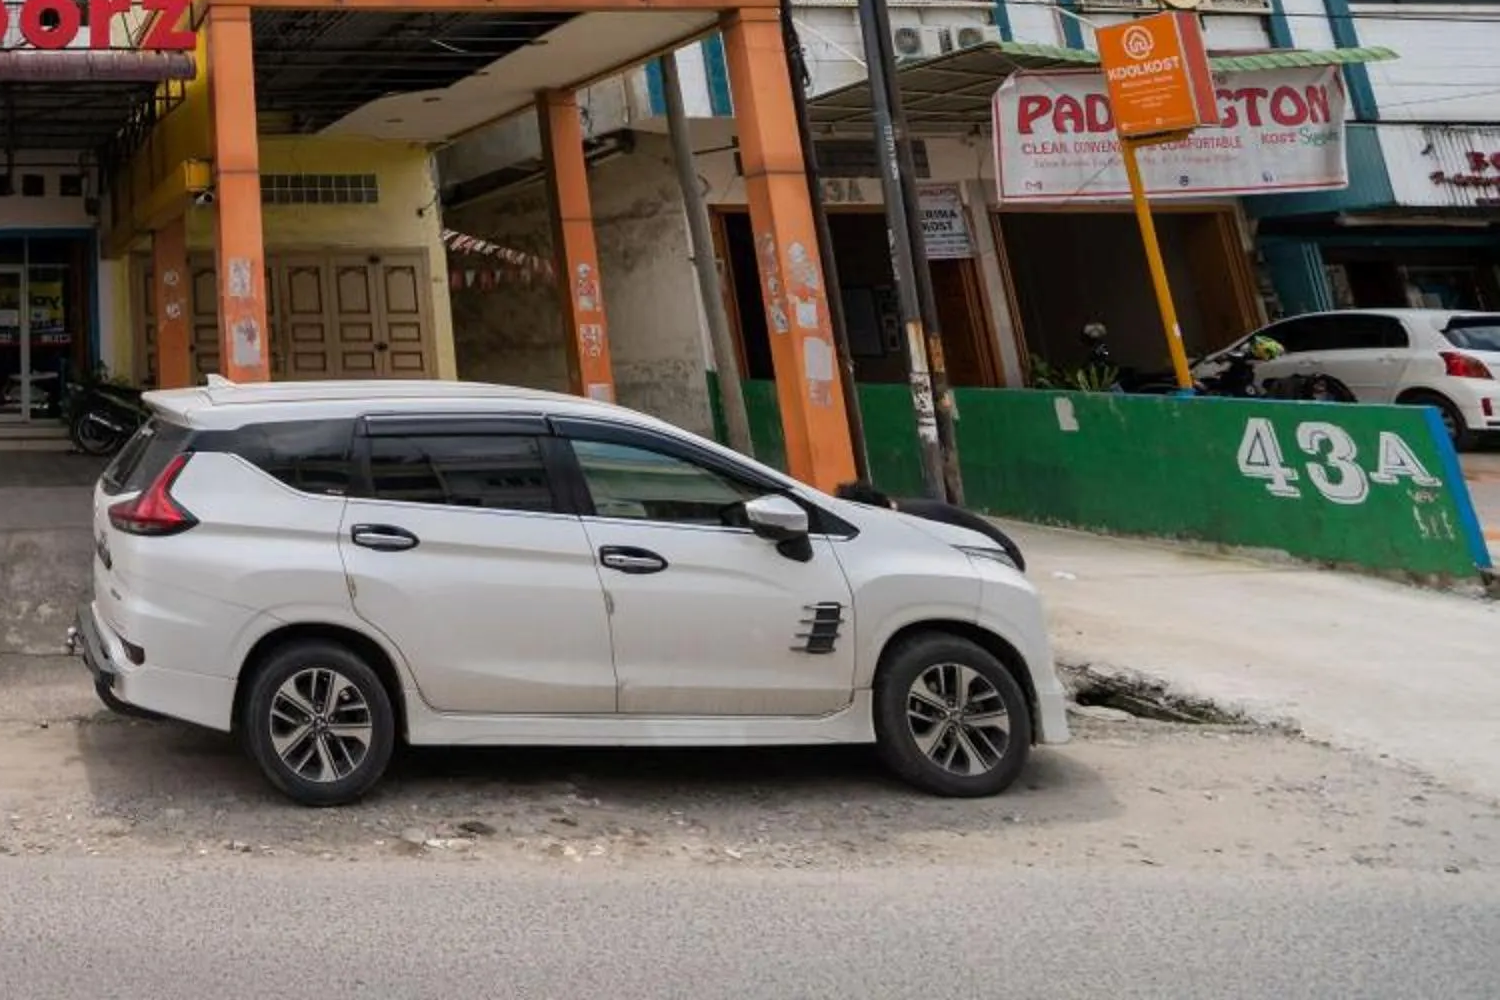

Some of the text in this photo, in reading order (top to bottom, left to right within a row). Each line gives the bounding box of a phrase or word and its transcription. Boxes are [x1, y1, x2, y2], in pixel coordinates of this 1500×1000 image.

[1107, 55, 1180, 80] KOOLKOST
[1017, 85, 1331, 135] PADGTON
[1237, 417, 1443, 505] 43A
